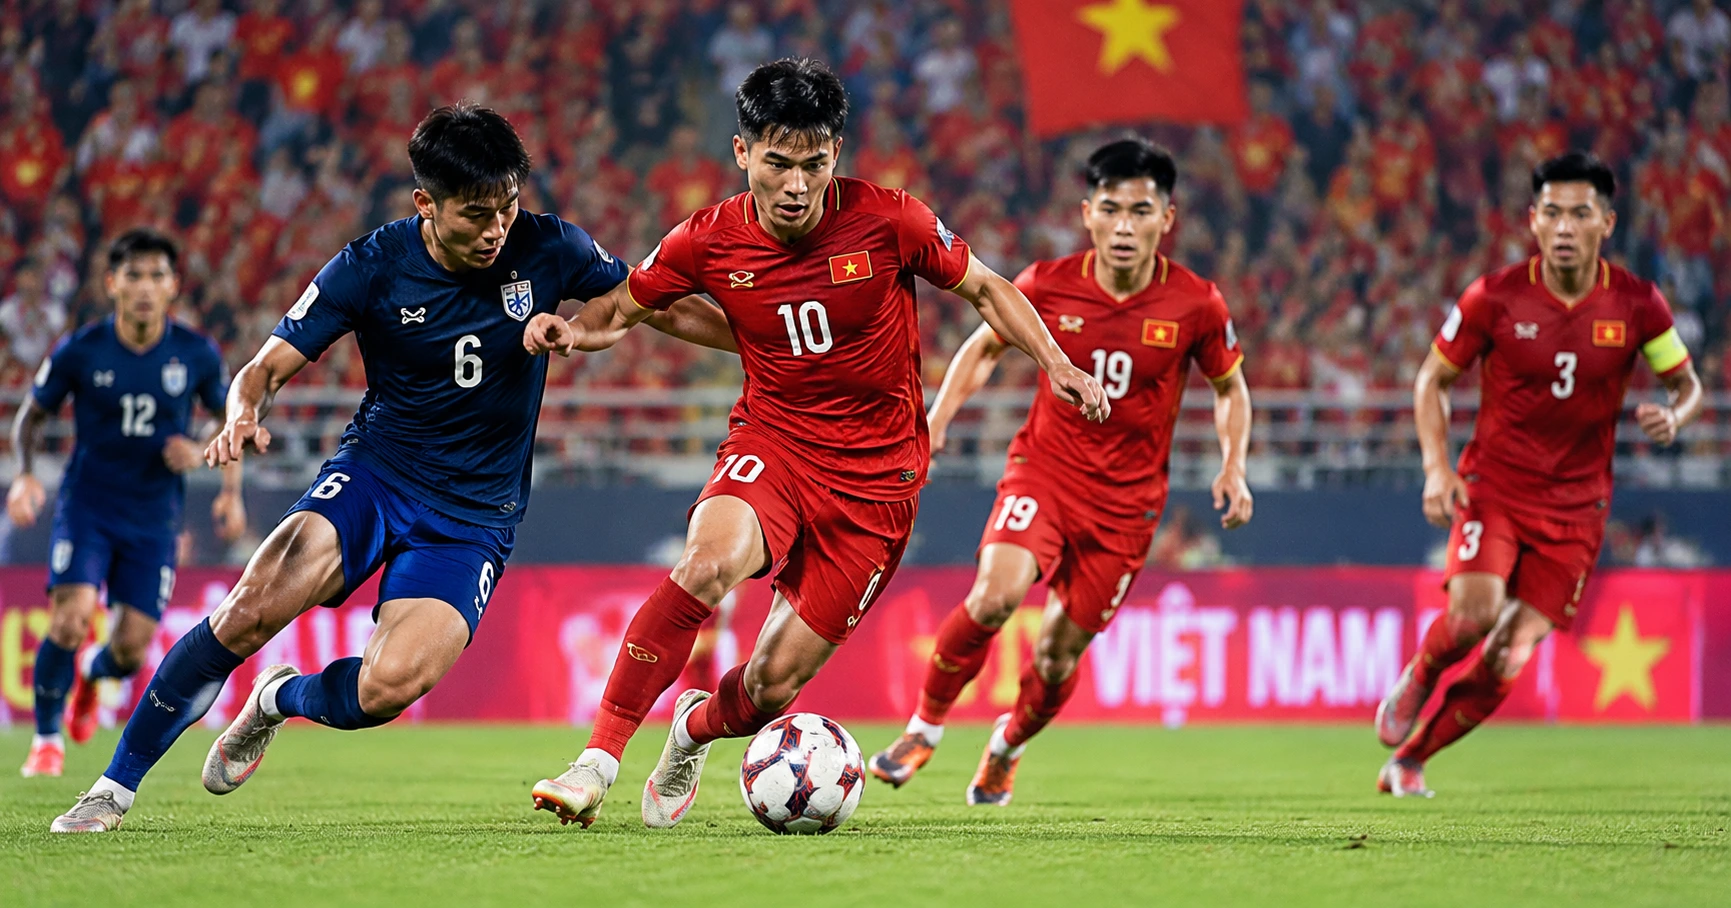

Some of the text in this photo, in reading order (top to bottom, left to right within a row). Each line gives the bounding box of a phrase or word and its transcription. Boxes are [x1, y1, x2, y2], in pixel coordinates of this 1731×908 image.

[777, 300, 833, 356] 10
[454, 334, 483, 388] 6
[1091, 348, 1133, 400] 19
[1551, 352, 1577, 398] 3
[120, 392, 157, 437] 12
[311, 472, 351, 499] 6
[712, 454, 765, 484] 10
[994, 494, 1038, 532] 19
[1458, 520, 1483, 561] 3
[1090, 582, 1238, 729] VIỆT
[1248, 606, 1402, 707] NAM
